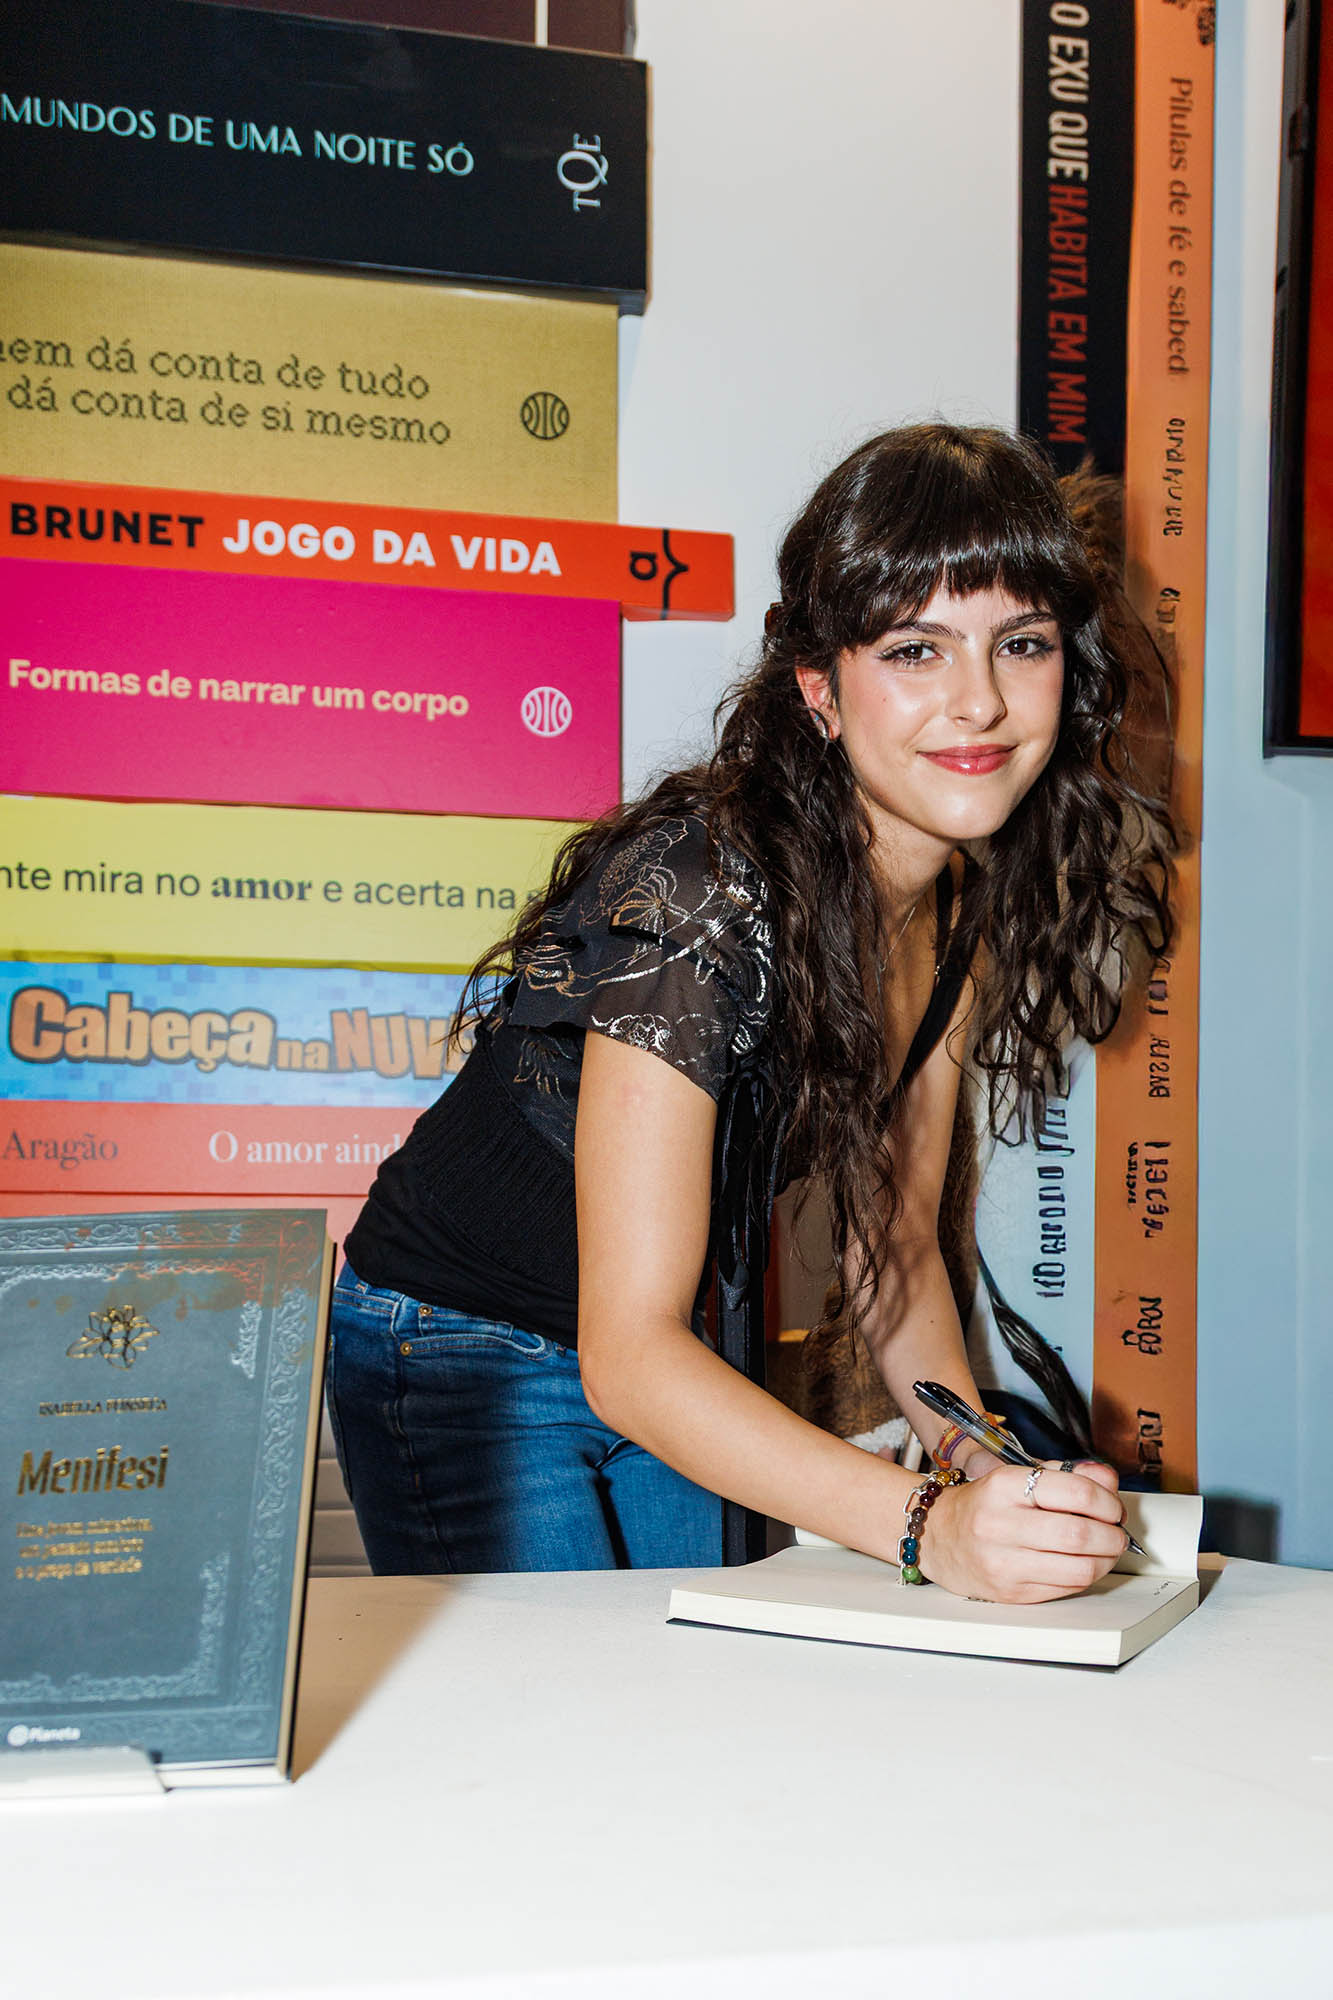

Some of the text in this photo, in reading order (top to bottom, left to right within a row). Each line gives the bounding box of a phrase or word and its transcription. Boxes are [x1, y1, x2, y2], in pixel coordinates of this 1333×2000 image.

[1, 92, 474, 177] MUNDOS DE UMA NOITE SÓ
[1047, 3, 1090, 444] O EXU QUE HABITA EM MIM
[1169, 180, 1192, 218] de
[1169, 226, 1193, 252] fé
[1169, 260, 1187, 276] e
[87, 335, 137, 374] dá
[150, 350, 263, 385] conta
[277, 354, 324, 390] de
[338, 365, 430, 400] tudo
[7, 374, 452, 445] dá conta de si mesmo
[10, 503, 562, 577] BRUNET JOGO DA VIDA
[9, 659, 469, 721] Formas de narrar um corpo
[64, 862, 143, 895] mira
[156, 872, 200, 896] no
[211, 873, 312, 901] amor
[323, 880, 342, 903] e
[354, 880, 464, 908] acerta
[476, 888, 516, 910] na
[8, 986, 277, 1072] Cabeça
[277, 1038, 331, 1071] na
[2, 1131, 119, 1168] Aragão
[209, 1132, 238, 1163] O
[247, 1138, 328, 1164] amor
